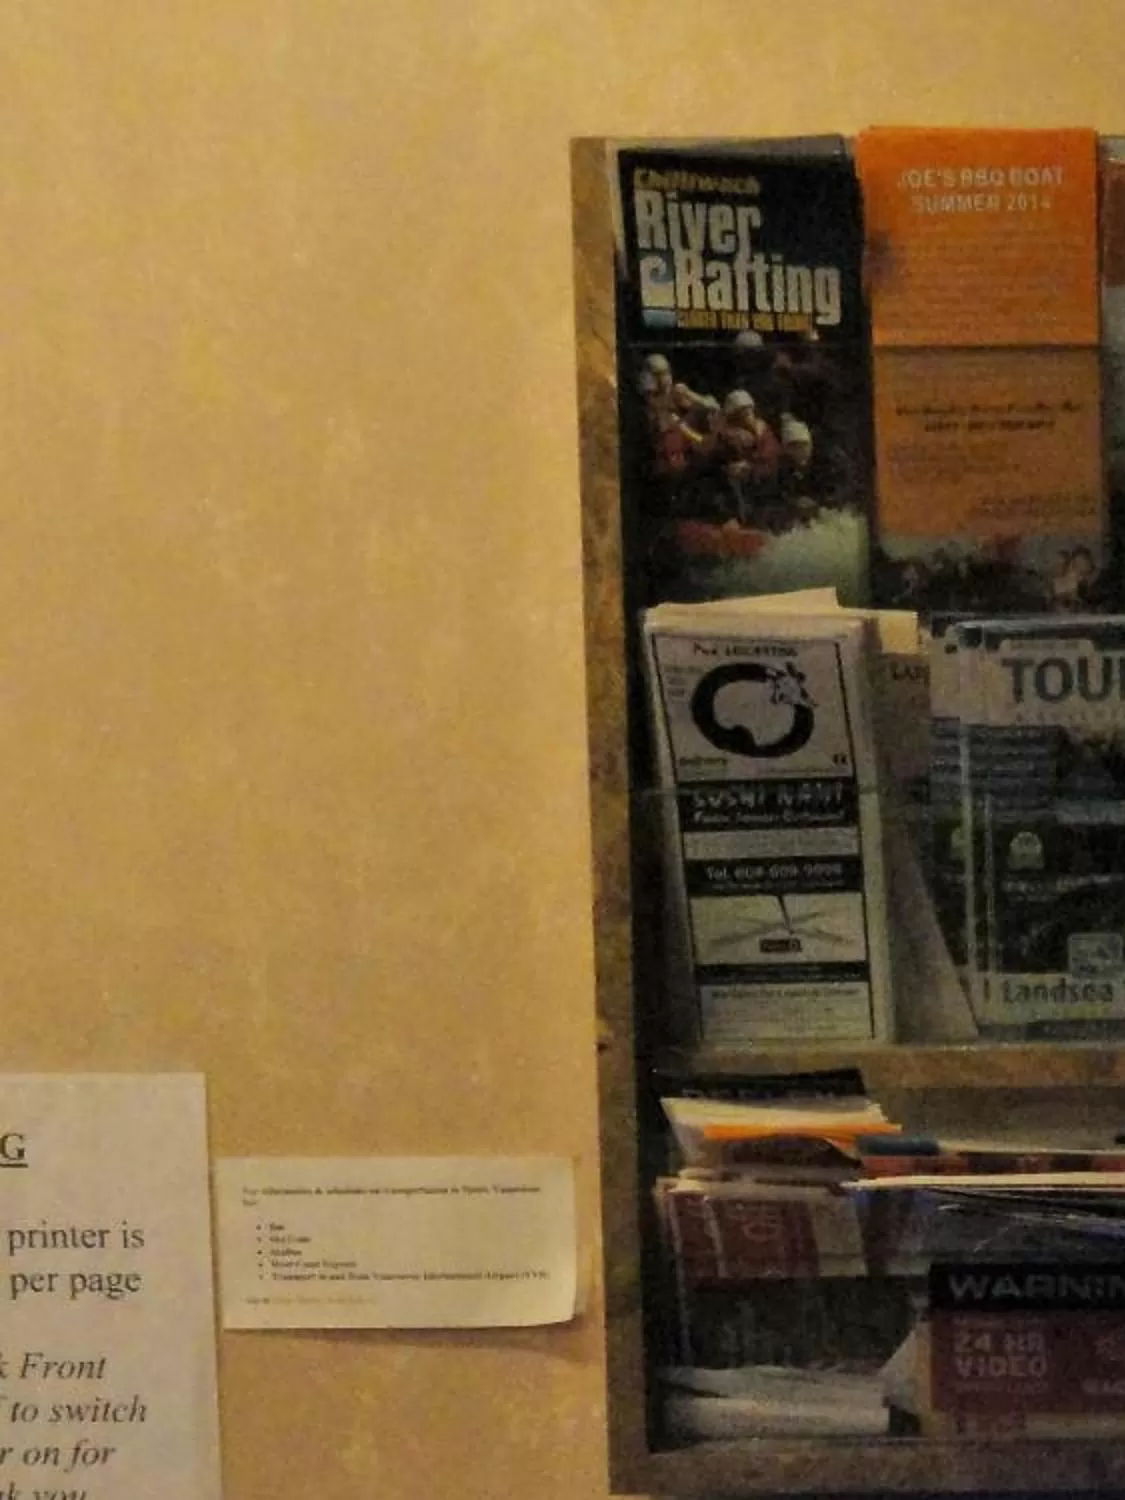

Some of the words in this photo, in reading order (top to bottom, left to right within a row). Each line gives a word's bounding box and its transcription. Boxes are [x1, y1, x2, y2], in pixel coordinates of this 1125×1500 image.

[633, 188, 762, 254] River
[674, 250, 842, 326] Rafting
[8, 1219, 111, 1257] printer
[122, 1219, 145, 1249] is
[10, 1270, 60, 1300] per
[69, 1271, 142, 1300] page
[19, 1351, 107, 1380] Front
[955, 1355, 1049, 1378] VIDEO
[11, 1401, 39, 1422] to
[48, 1394, 147, 1423] switch
[22, 1447, 60, 1466] on
[63, 1437, 117, 1473] for
